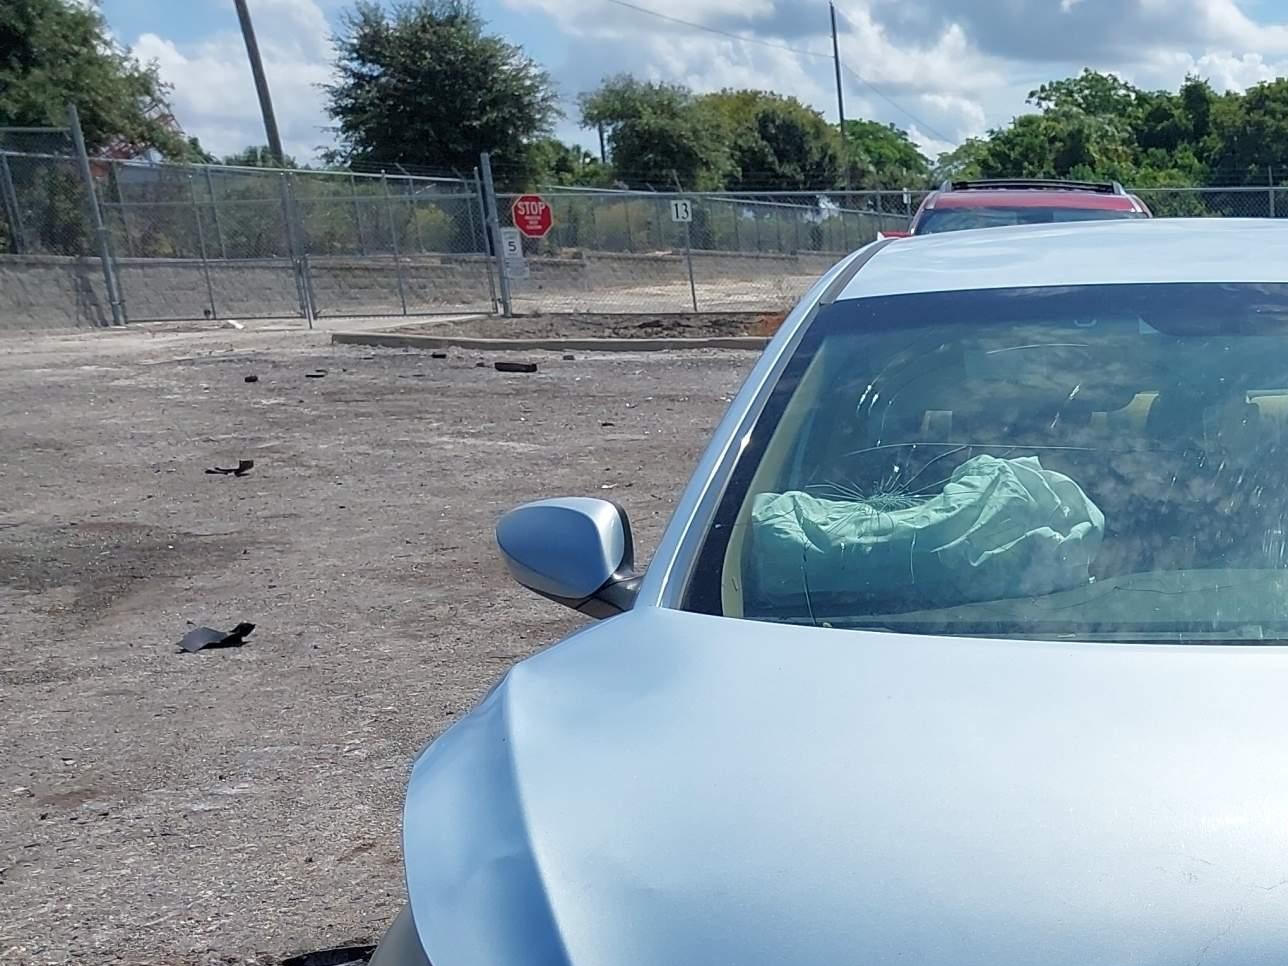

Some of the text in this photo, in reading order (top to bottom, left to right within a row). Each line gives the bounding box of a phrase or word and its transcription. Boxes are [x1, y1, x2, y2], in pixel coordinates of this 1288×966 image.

[517, 201, 546, 216] STOP
[674, 202, 689, 220] 13
[508, 241, 517, 252] 5
